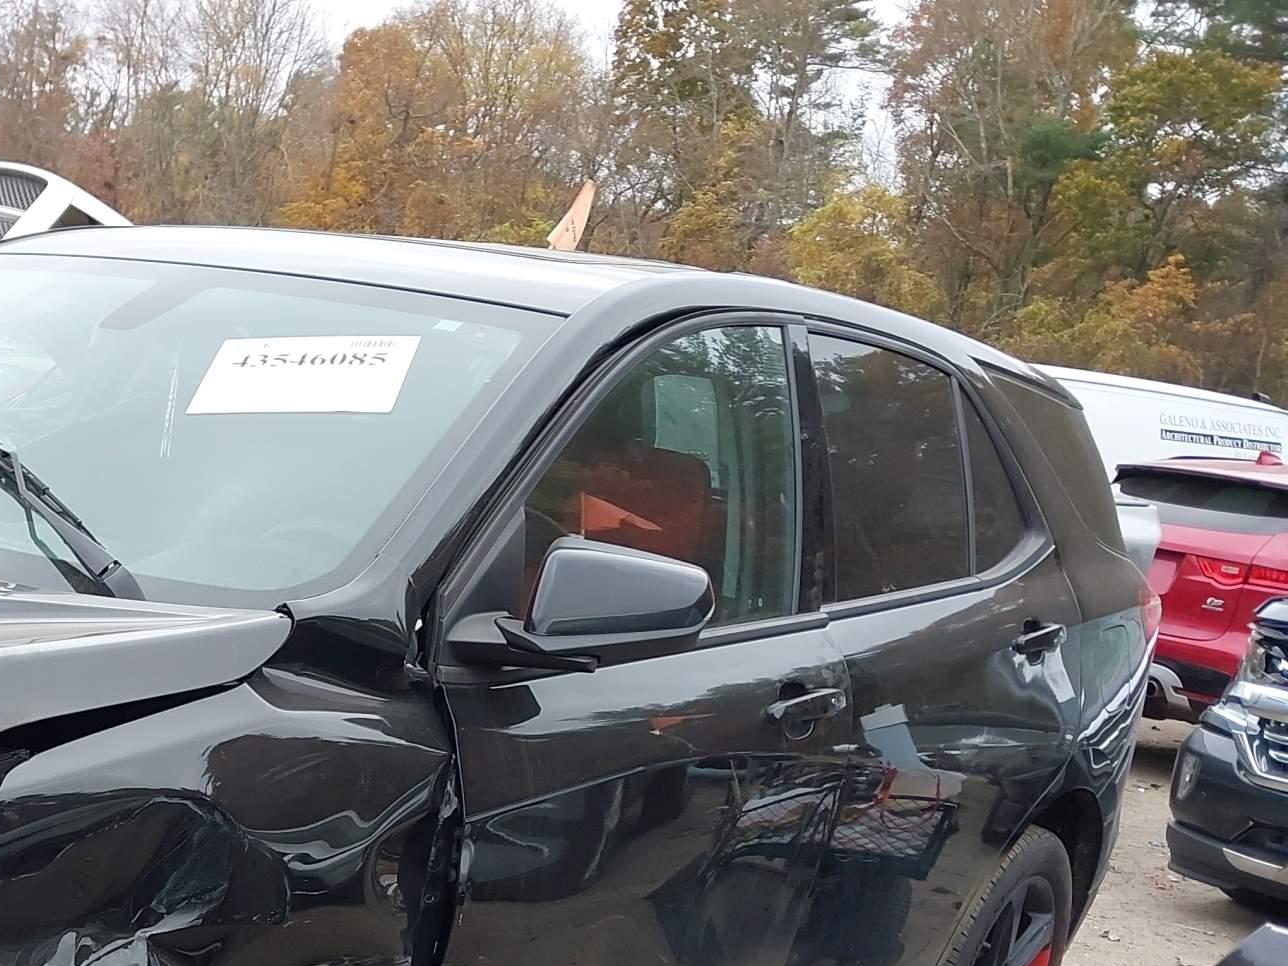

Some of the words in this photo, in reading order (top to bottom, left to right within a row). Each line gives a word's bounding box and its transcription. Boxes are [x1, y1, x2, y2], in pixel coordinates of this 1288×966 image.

[232, 352, 388, 368] 43546085
[1159, 413, 1199, 428] GALENO
[1200, 417, 1209, 430] &
[1211, 418, 1263, 437] ASSOCIATES
